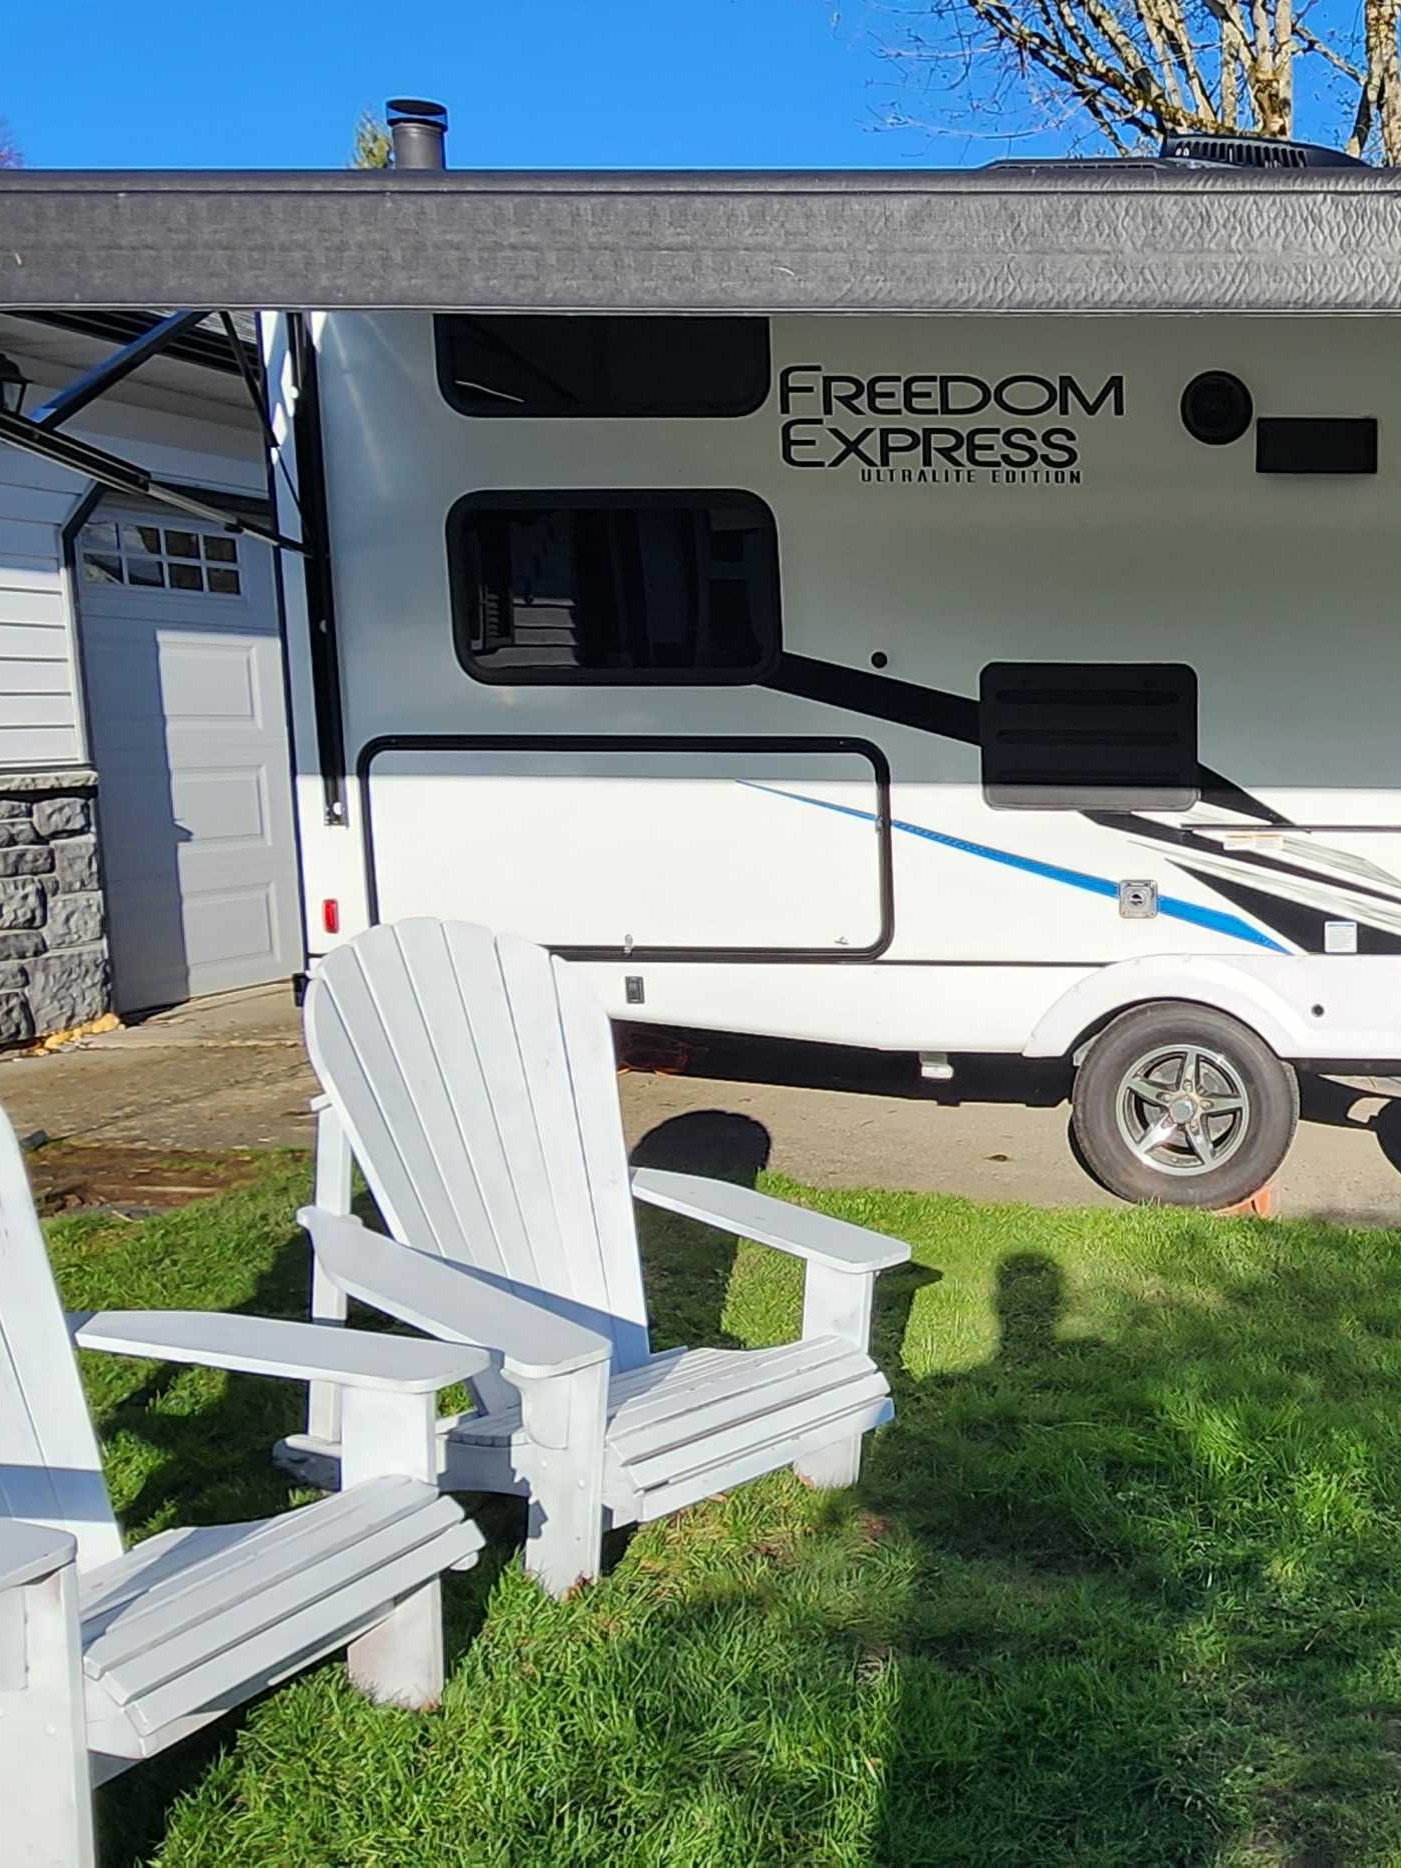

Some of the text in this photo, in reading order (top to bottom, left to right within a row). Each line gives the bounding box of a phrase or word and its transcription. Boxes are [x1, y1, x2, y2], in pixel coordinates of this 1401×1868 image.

[779, 365, 1125, 416] FREEDOM
[781, 418, 1079, 468] EXPRESS
[860, 468, 1082, 484] ULTRALITE EDITION
